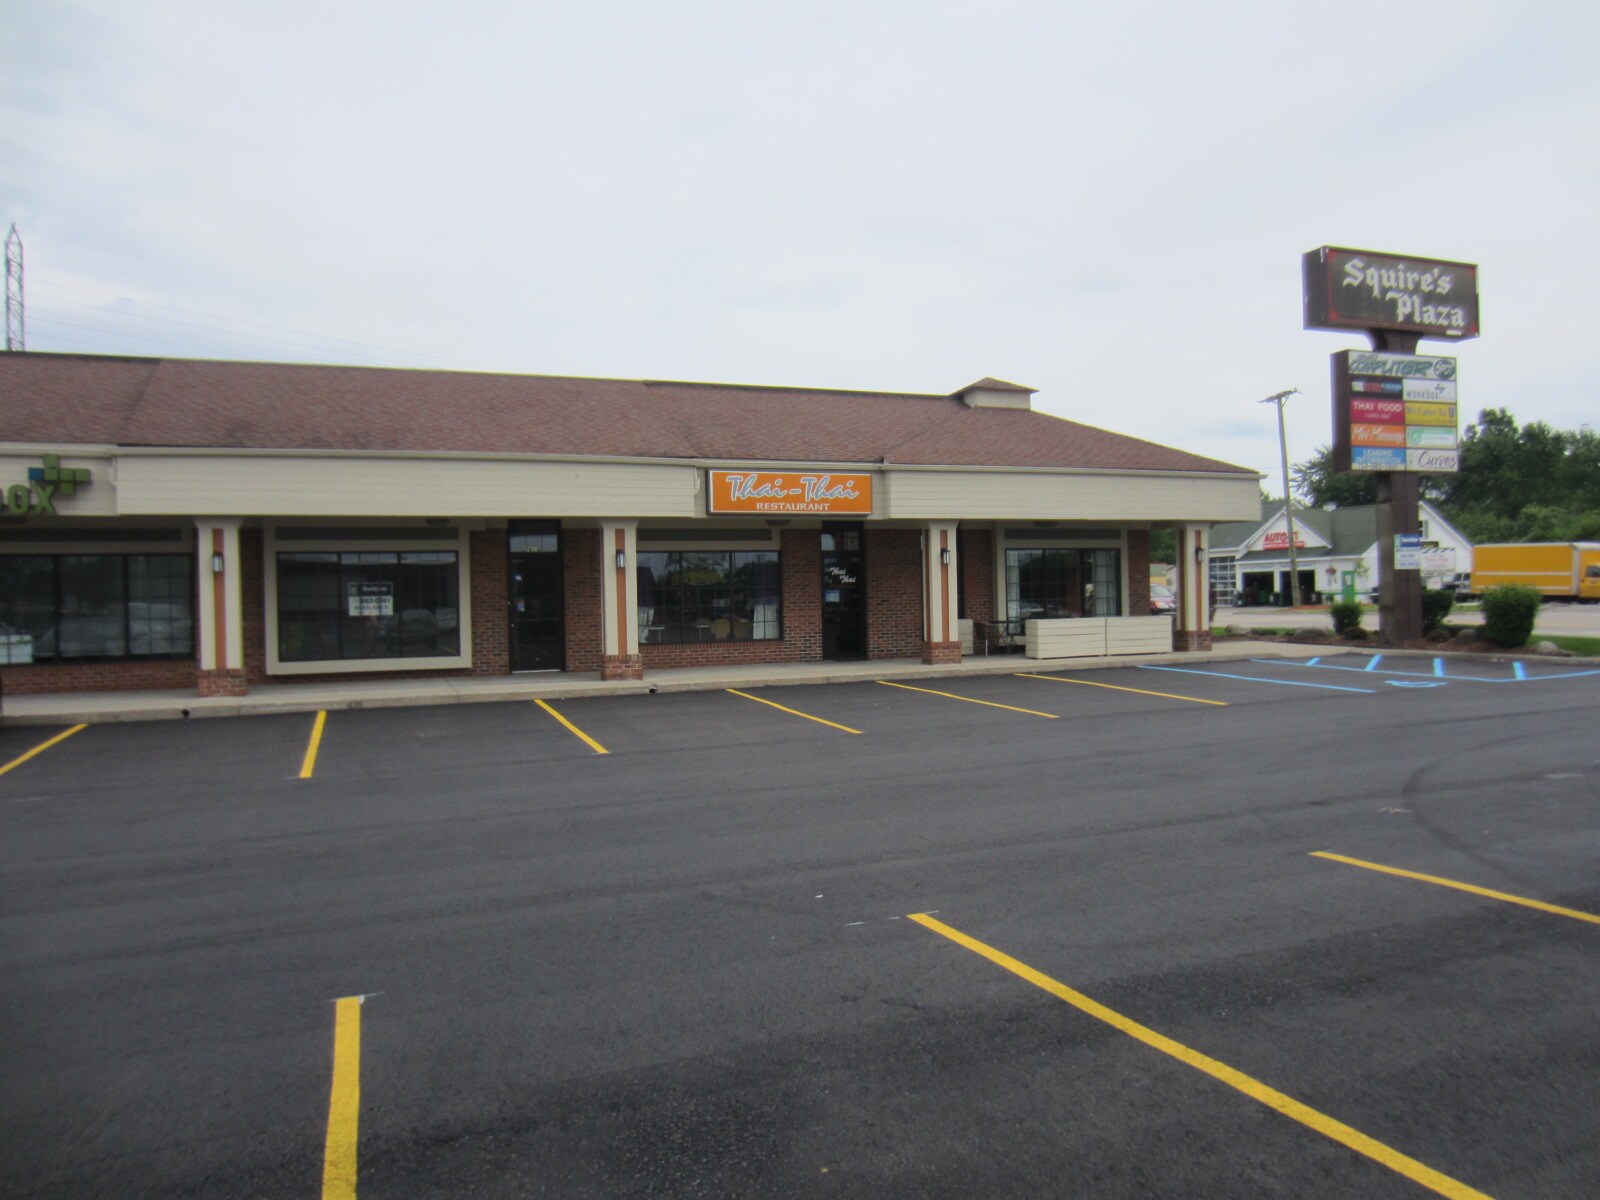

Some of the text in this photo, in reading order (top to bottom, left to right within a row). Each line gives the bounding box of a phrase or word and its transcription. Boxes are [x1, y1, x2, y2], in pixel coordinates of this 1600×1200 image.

[1343, 259, 1451, 297] Squire's
[1386, 291, 1465, 328] Plaza
[1352, 401, 1403, 413] THAI FOOD
[1418, 450, 1456, 469] Curves
[756, 502, 830, 511] RESTAURANT
